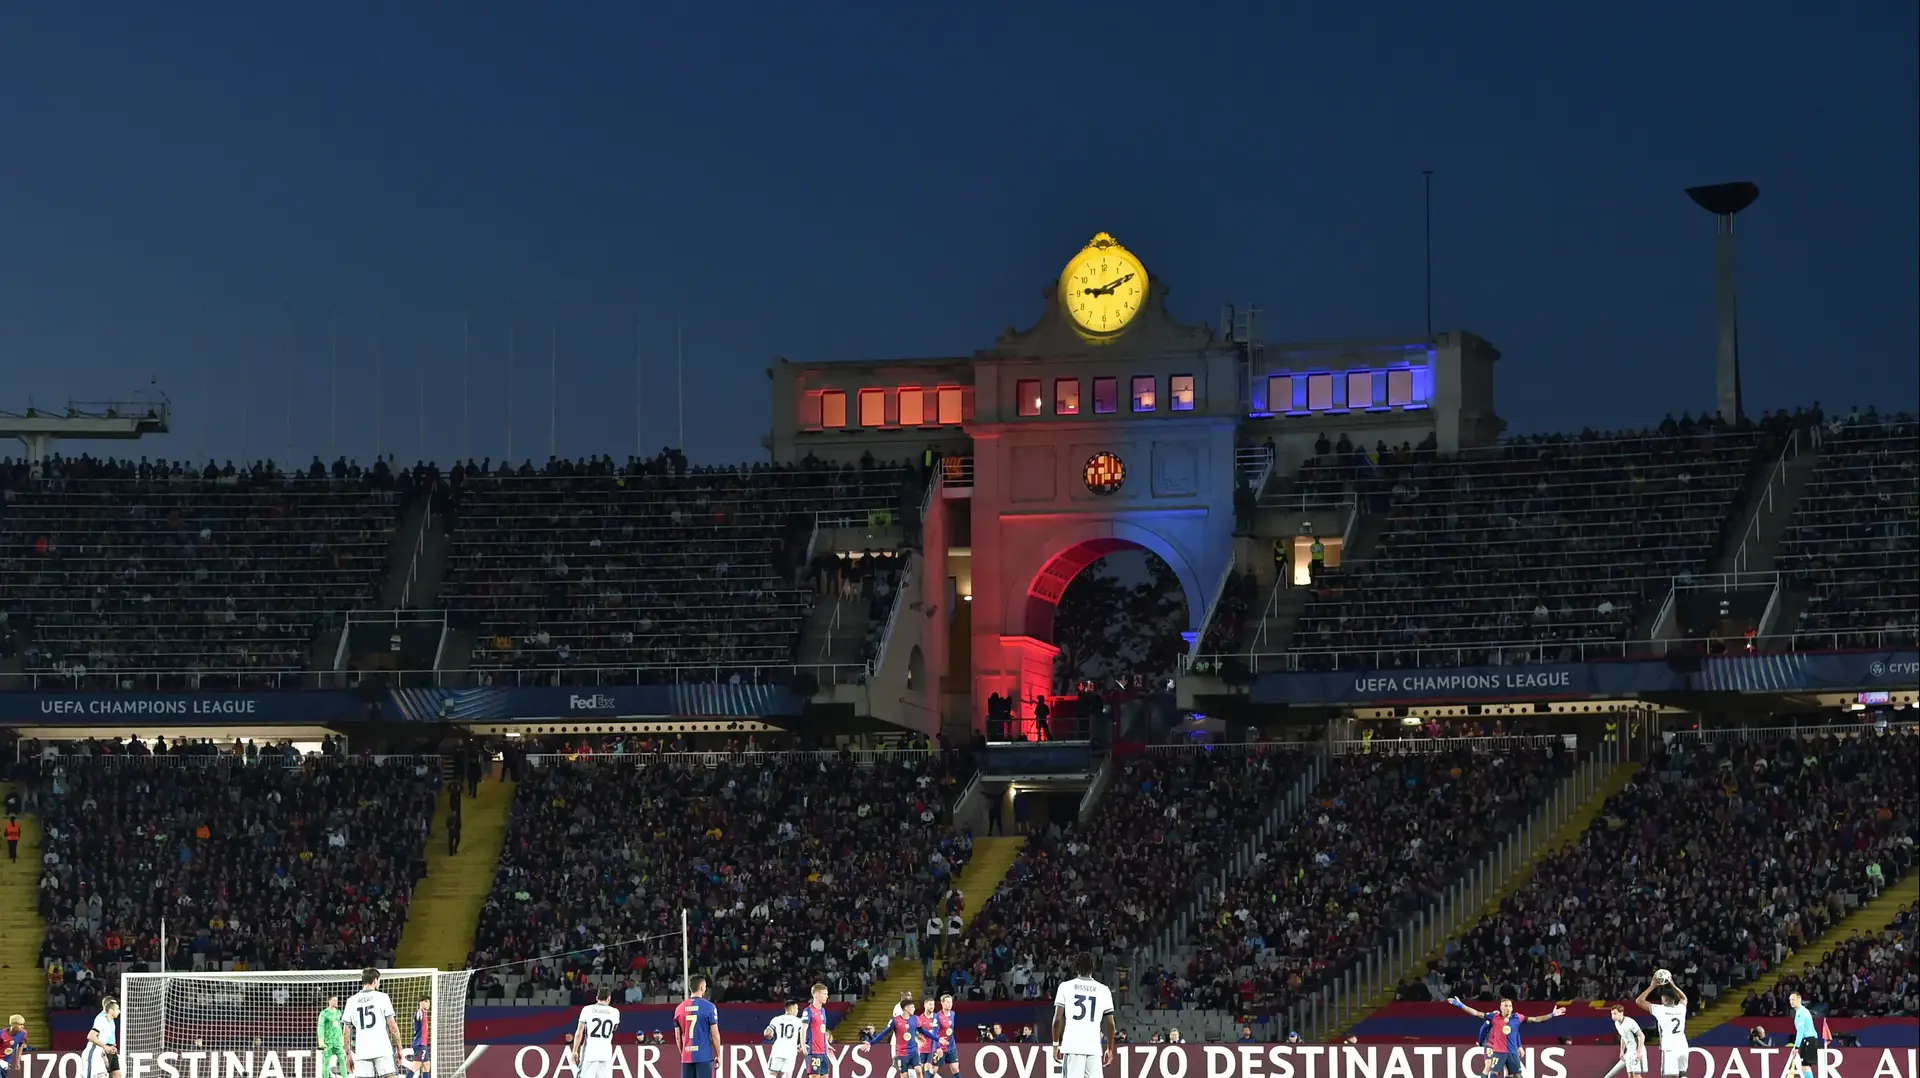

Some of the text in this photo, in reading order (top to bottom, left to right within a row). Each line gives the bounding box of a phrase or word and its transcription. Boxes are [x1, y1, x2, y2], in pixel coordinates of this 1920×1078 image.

[1101, 264, 1108, 272] 12
[1081, 276, 1088, 284] 10
[1102, 315, 1106, 323] 6
[1355, 671, 1569, 692] UEFA CHAMPIONS LEAGUE
[41, 700, 256, 714] UEFA CHAMPIONS LEAGUE
[570, 694, 615, 709] FedEx
[357, 1005, 376, 1029] 15
[1072, 994, 1096, 1022] 31
[590, 1017, 613, 1038] 20
[686, 1014, 697, 1038] 7
[780, 1023, 795, 1039] 10
[1671, 1017, 1681, 1034] 2
[20, 1050, 416, 1078] 170 ESTINATIS
[514, 1045, 662, 1078] QAAR
[974, 1045, 1064, 1078] OVE
[1116, 1045, 1188, 1078] 170
